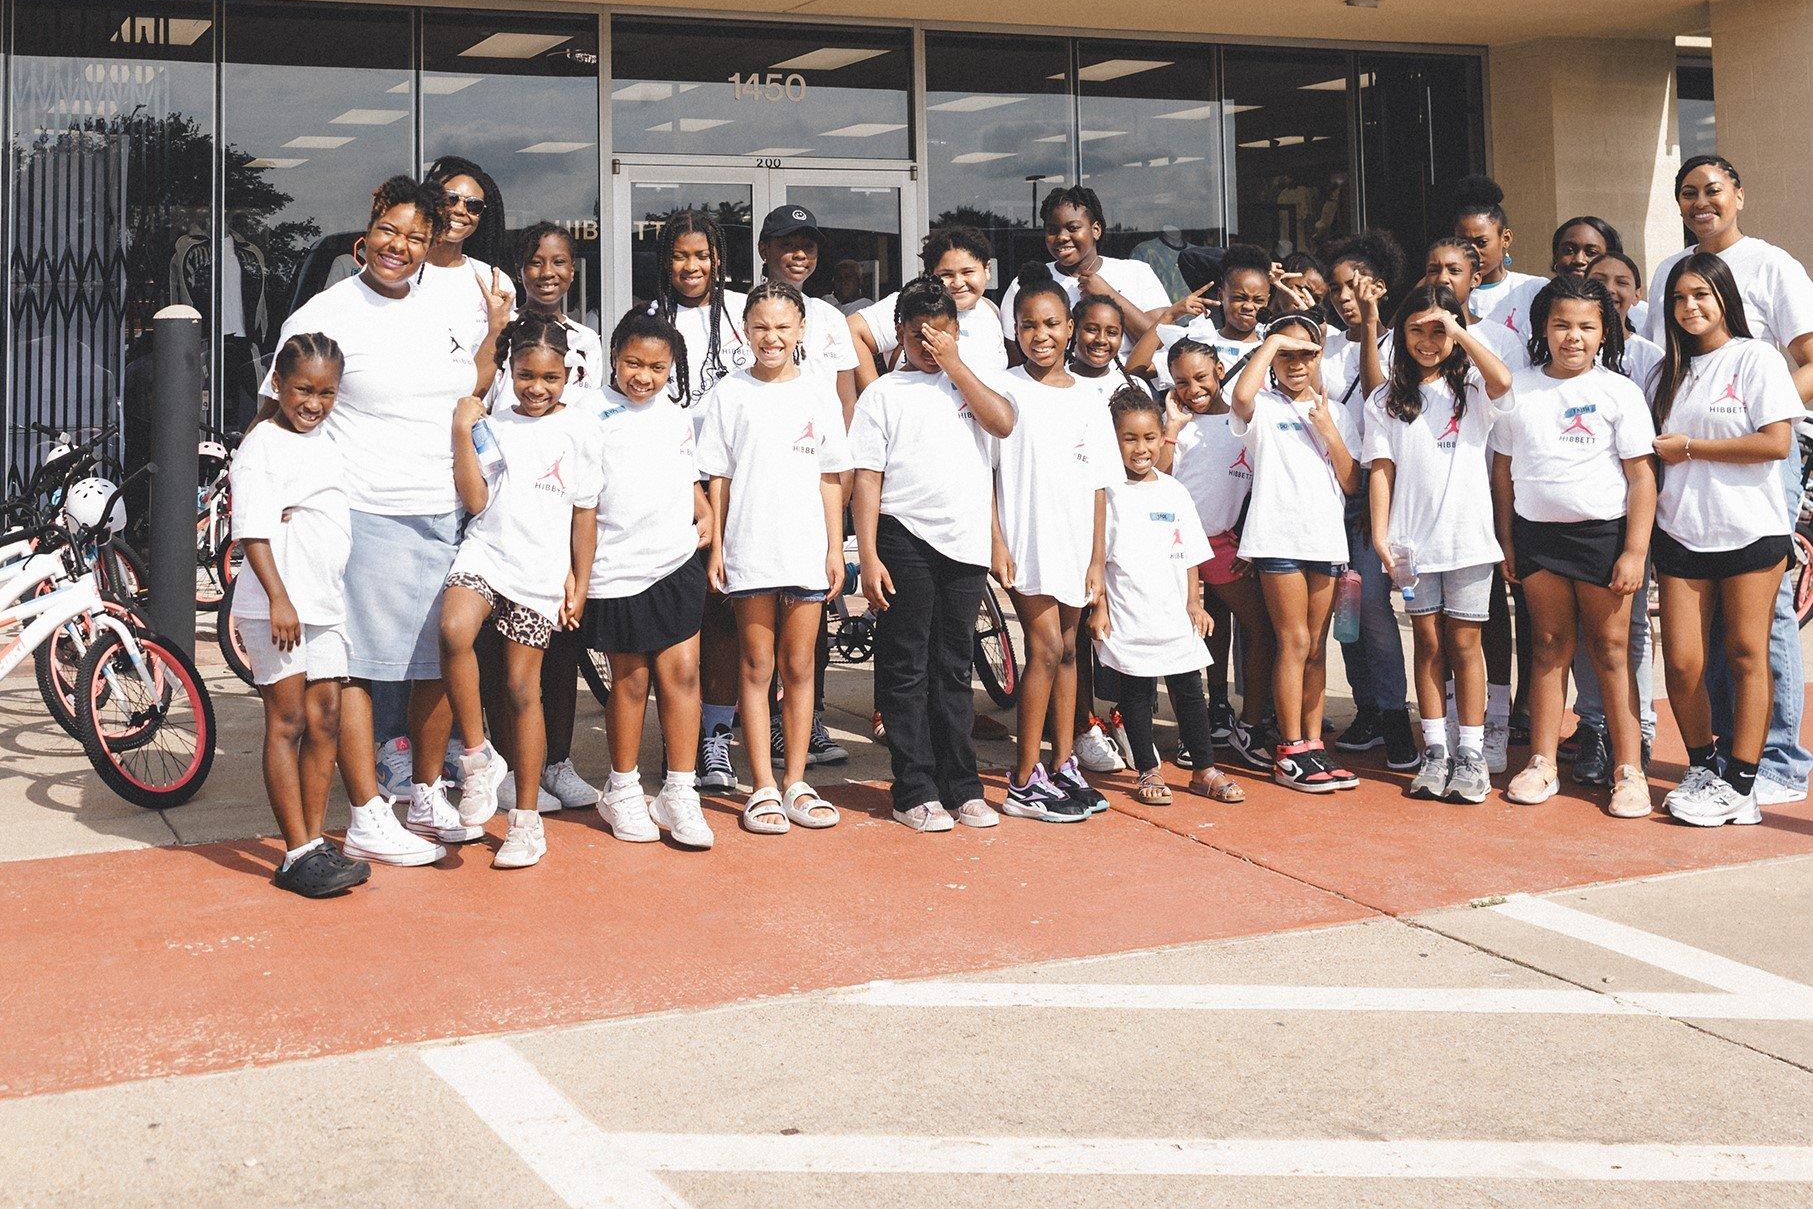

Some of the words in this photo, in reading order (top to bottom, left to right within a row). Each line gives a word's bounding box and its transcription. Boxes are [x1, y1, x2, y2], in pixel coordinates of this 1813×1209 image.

[728, 73, 806, 102] 1450
[756, 158, 782, 169] 200
[1558, 435, 1596, 444] HIBBETT
[793, 445, 815, 455] HIBBE
[1437, 441, 1457, 449] HIBB
